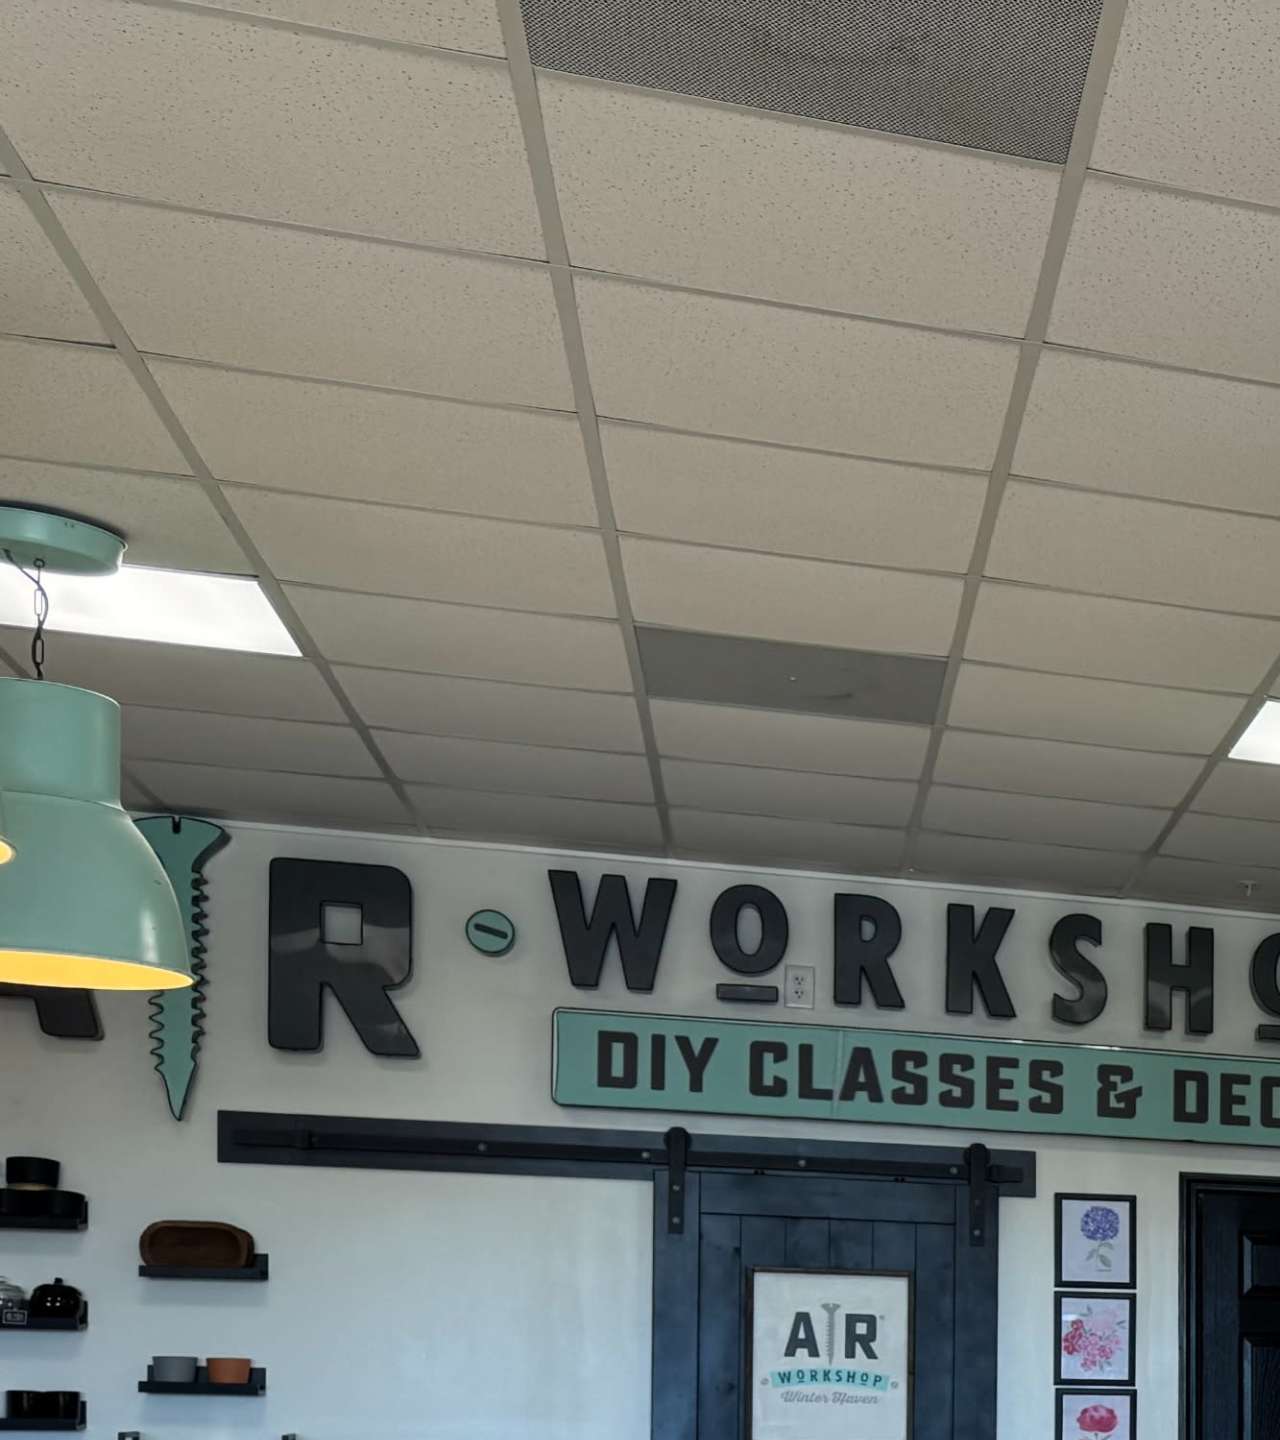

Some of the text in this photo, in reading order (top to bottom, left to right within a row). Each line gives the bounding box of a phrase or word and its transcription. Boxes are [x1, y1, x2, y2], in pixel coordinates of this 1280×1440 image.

[597, 1030, 719, 1093] DIY
[748, 1040, 1065, 1114] CLASSES
[1096, 1063, 1143, 1120] &
[777, 1369, 882, 1387] WORKSHOP
[780, 1391, 879, 1405] Winter Haven
